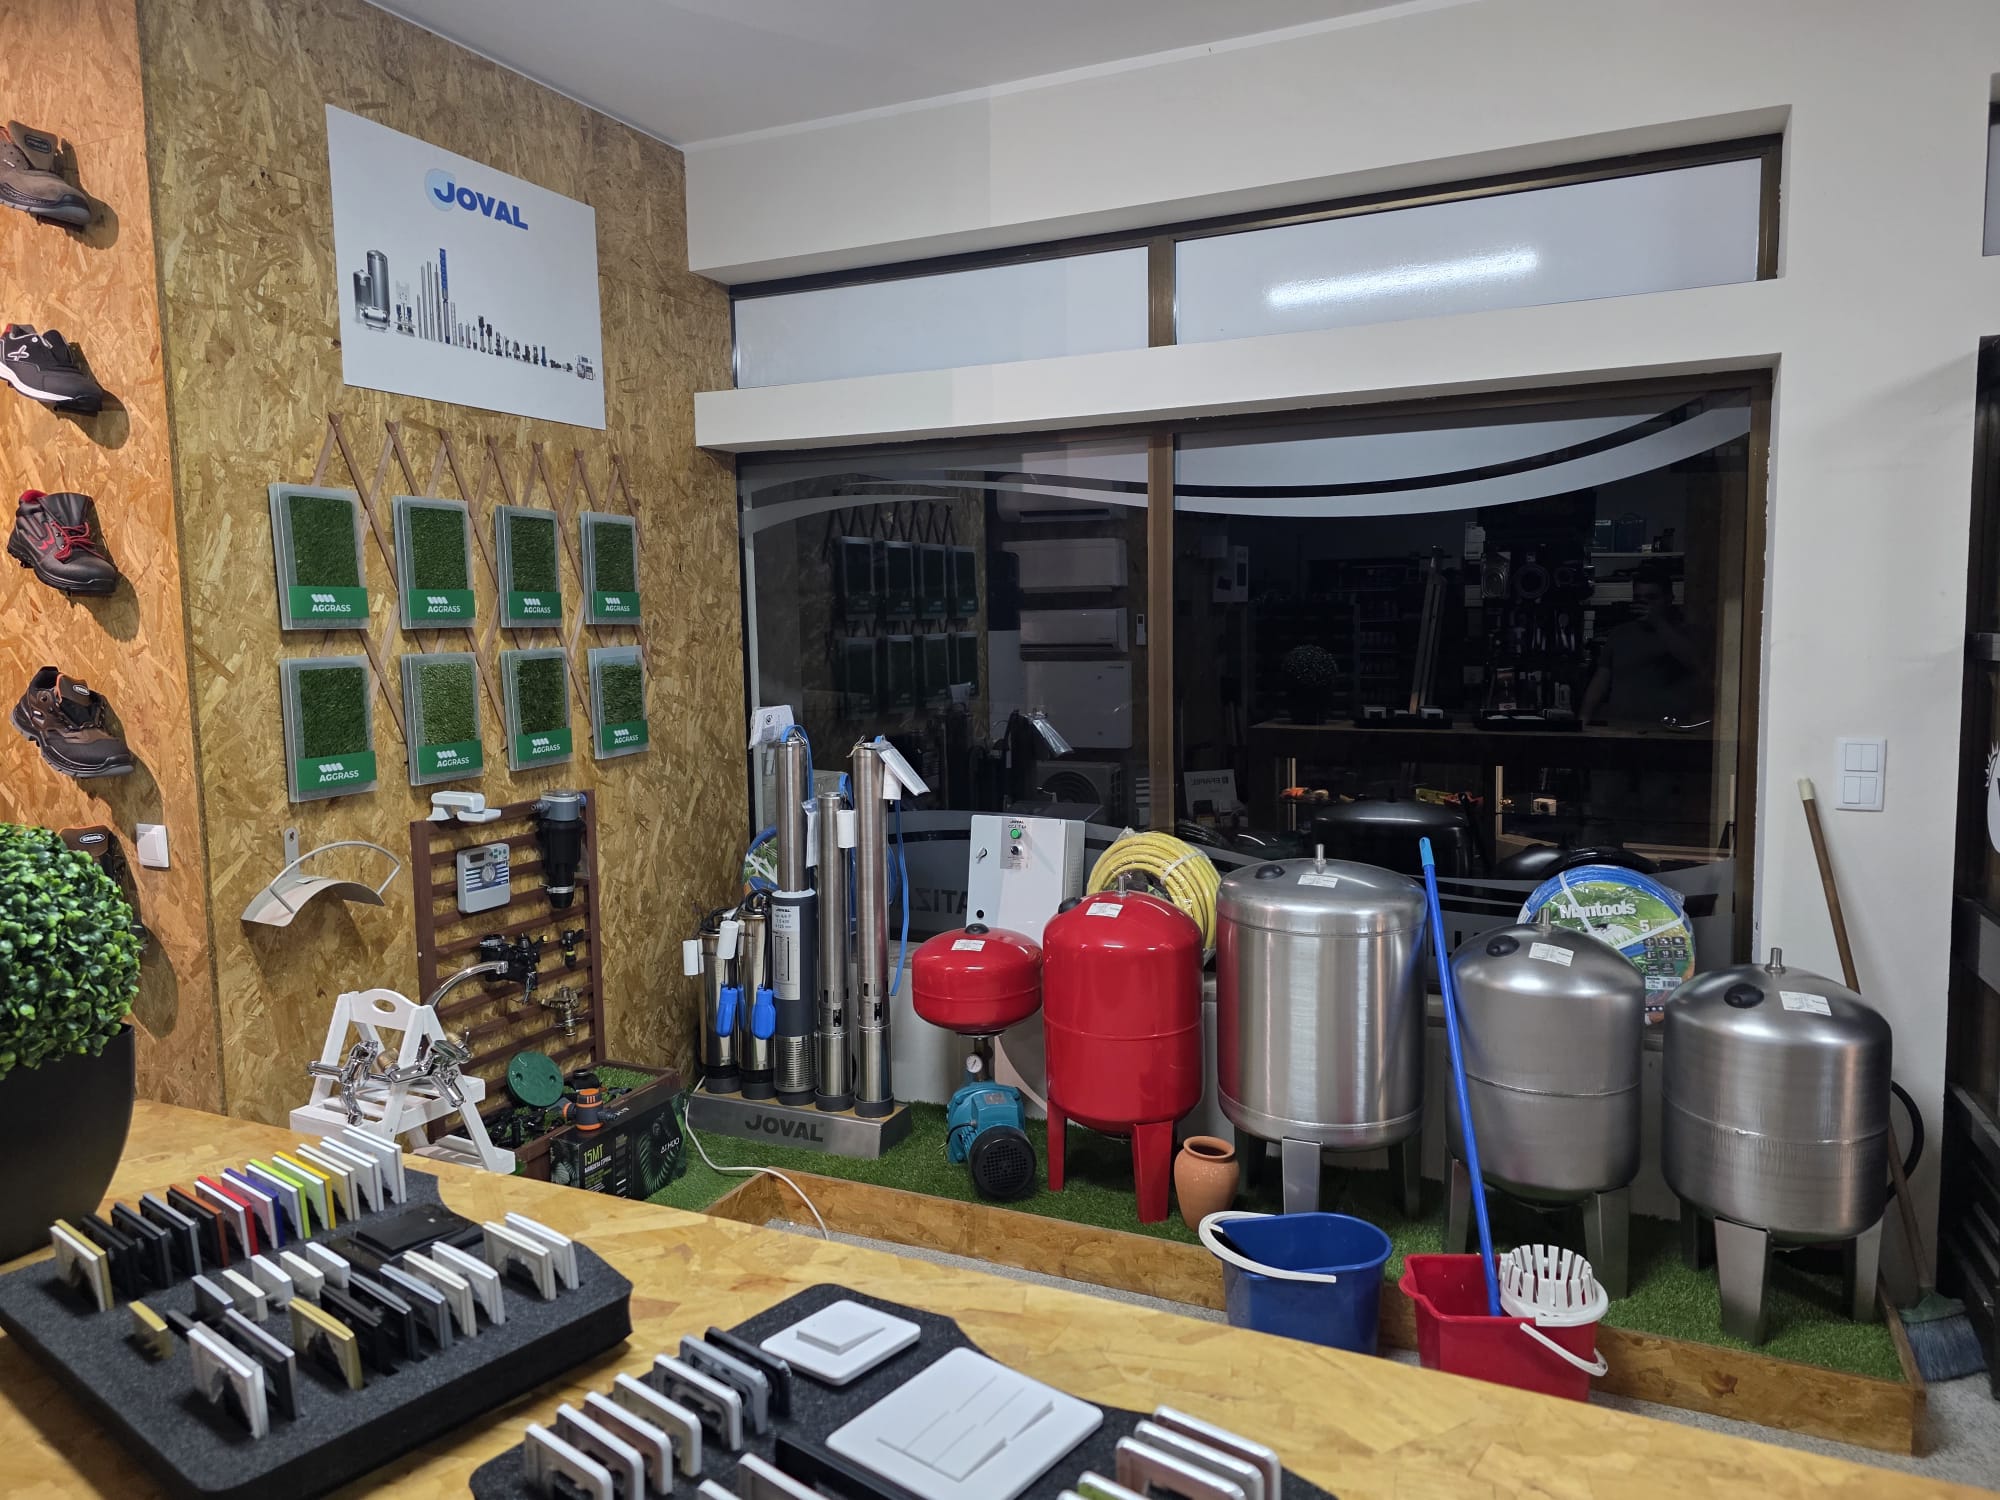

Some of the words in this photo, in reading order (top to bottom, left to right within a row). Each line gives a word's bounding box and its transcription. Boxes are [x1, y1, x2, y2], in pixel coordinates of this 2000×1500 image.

[433, 181, 529, 230] JOVAL
[311, 602, 352, 613] AGGRASS
[427, 604, 461, 614] AGGRASS
[523, 605, 551, 614] AGGRASS
[605, 604, 630, 613] AGGRASS
[614, 734, 639, 745] AGGRASS
[532, 742, 561, 755] AGGRASS
[437, 756, 470, 768] AGGRASS
[319, 769, 360, 783] AGGRASS
[745, 1114, 824, 1143] JOVAL
[584, 1144, 604, 1167] 15MT
